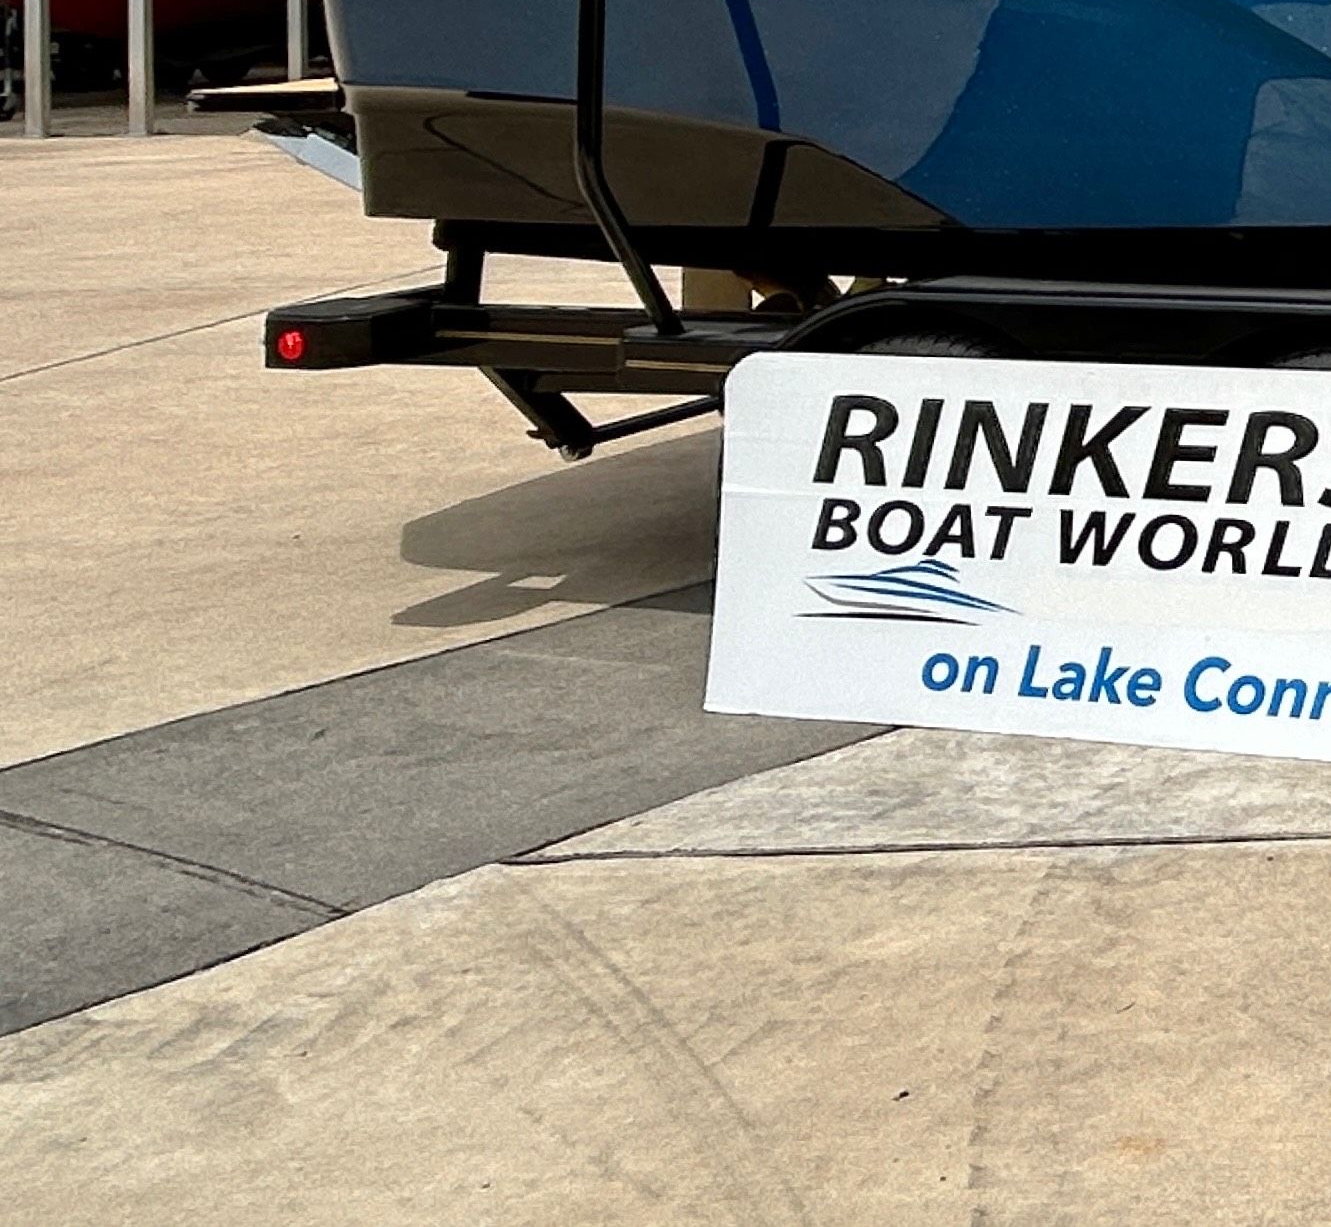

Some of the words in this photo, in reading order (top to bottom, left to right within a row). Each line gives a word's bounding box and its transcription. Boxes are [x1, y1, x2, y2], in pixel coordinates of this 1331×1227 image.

[811, 497, 1033, 561] BOAT
[921, 652, 1000, 695] on
[1017, 644, 1163, 707] Lake
